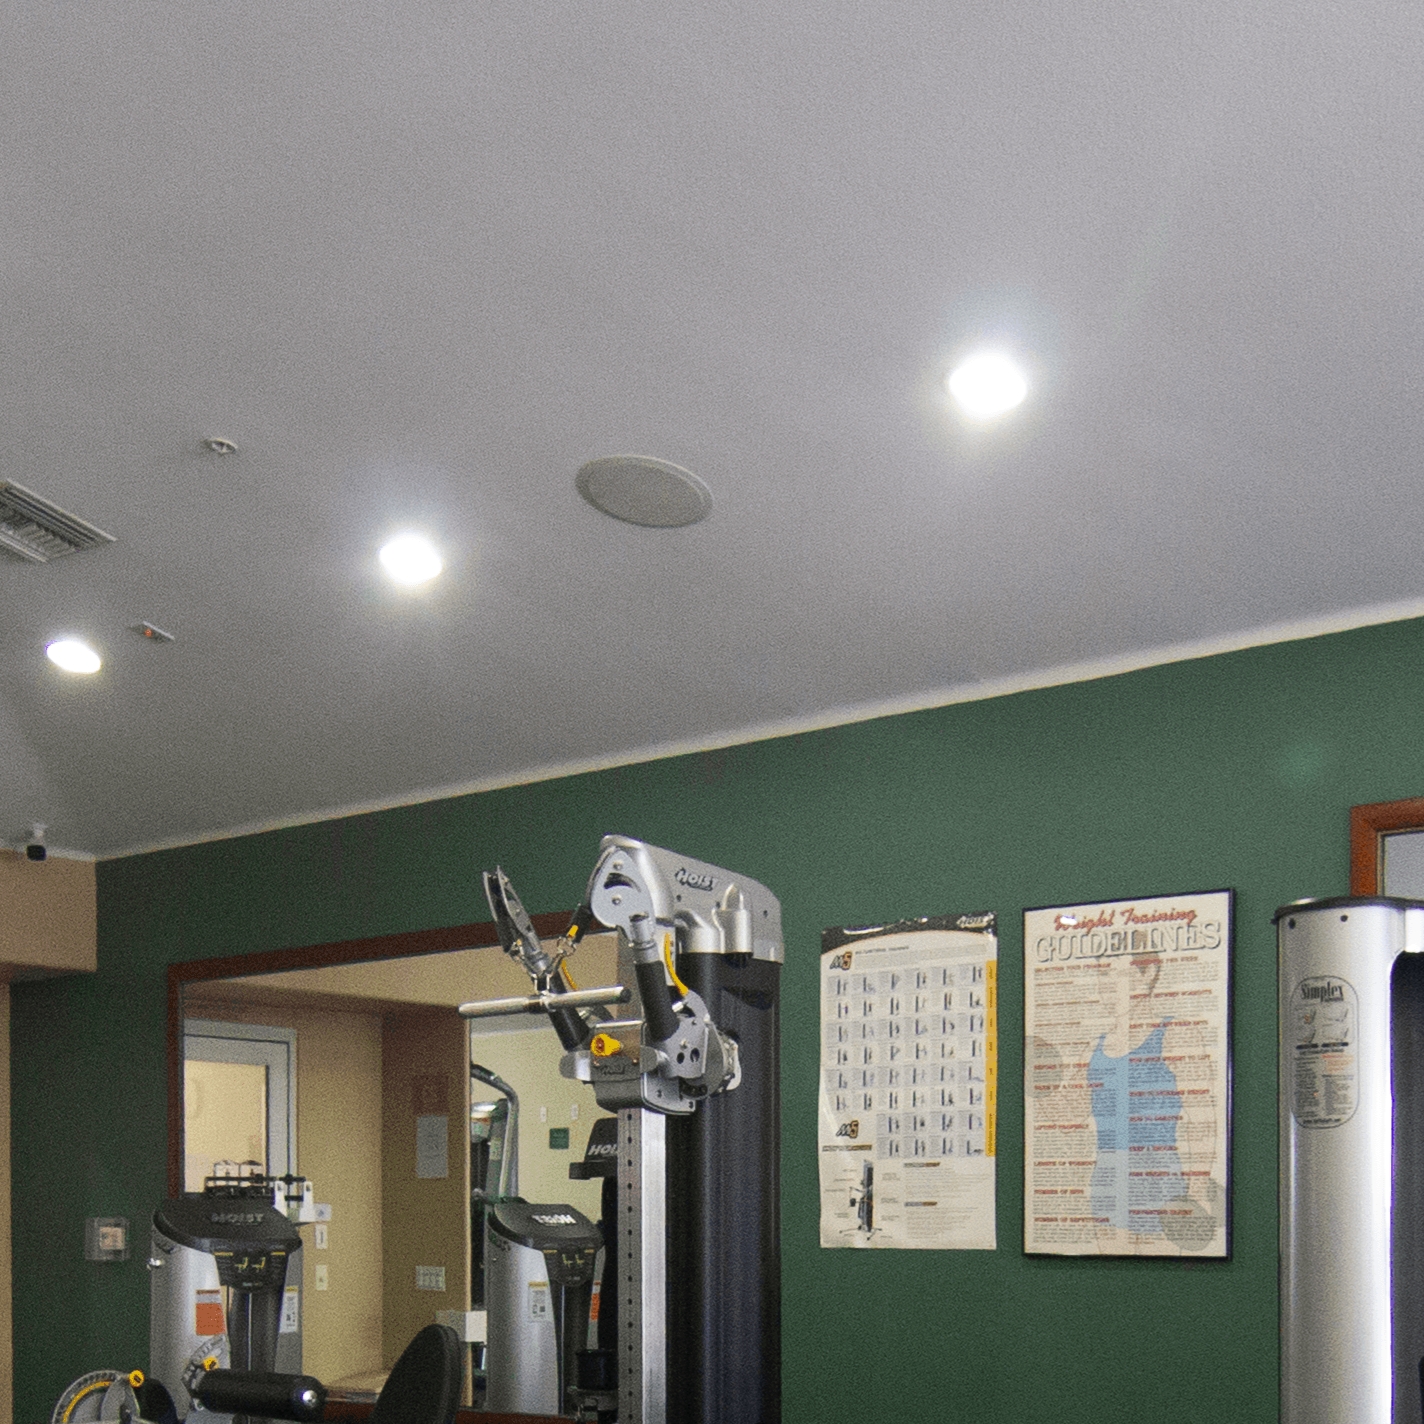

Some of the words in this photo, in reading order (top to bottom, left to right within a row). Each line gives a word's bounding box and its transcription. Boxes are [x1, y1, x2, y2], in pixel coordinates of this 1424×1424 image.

[674, 867, 717, 891] HOIST
[1120, 907, 1198, 926] Training
[1036, 921, 1221, 962] GUIDELINES
[829, 951, 853, 971] M5
[1300, 981, 1345, 1002] Simplex
[835, 1119, 859, 1138] M5
